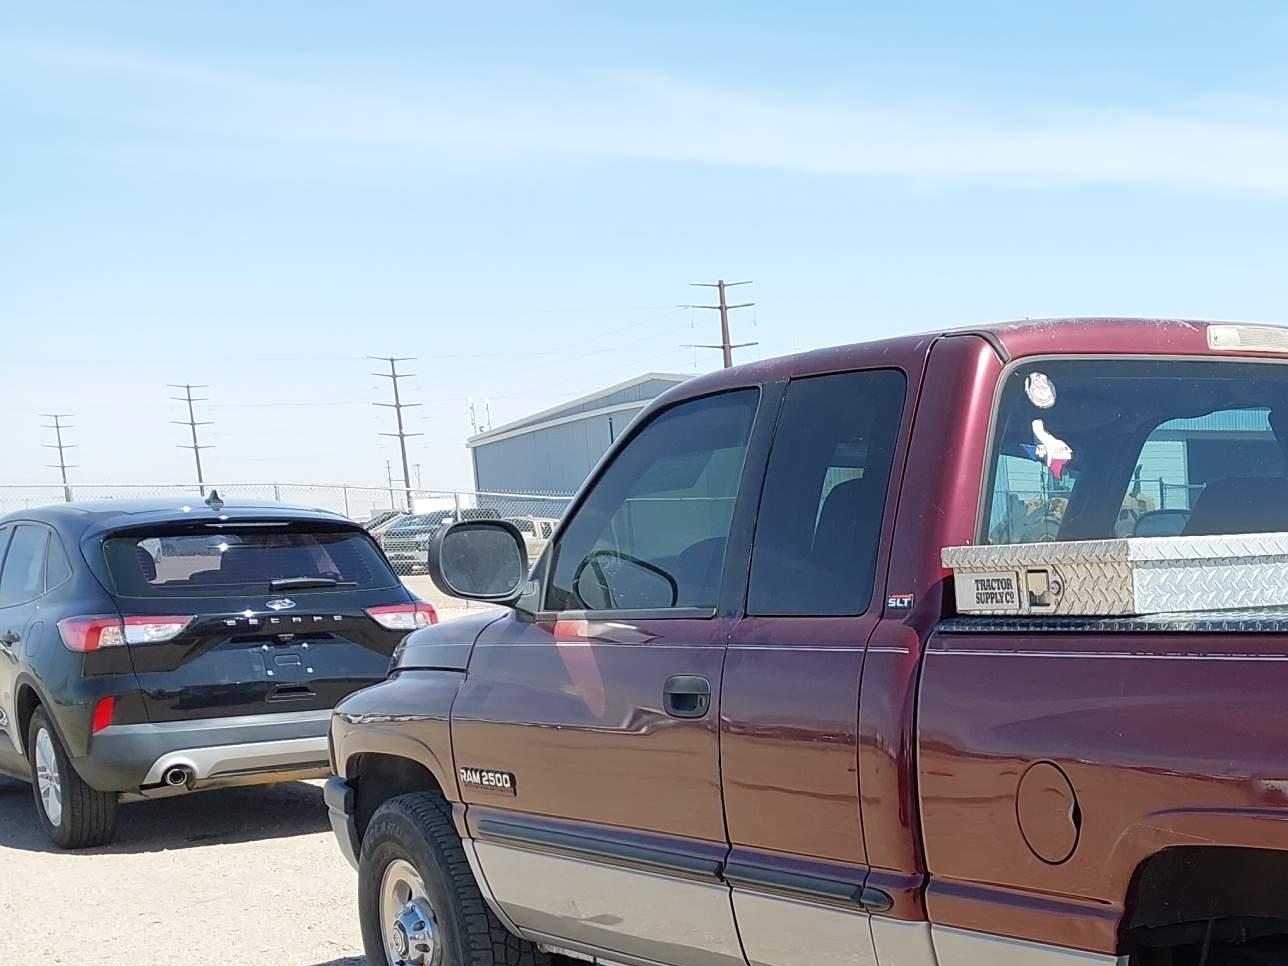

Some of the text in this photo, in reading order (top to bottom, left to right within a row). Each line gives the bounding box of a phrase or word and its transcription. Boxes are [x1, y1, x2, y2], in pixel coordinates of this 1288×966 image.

[975, 578, 1013, 591] TRACTOR
[888, 598, 911, 607] SLT
[975, 591, 1004, 604] SUPPLY
[460, 769, 511, 788] RAM 2500
